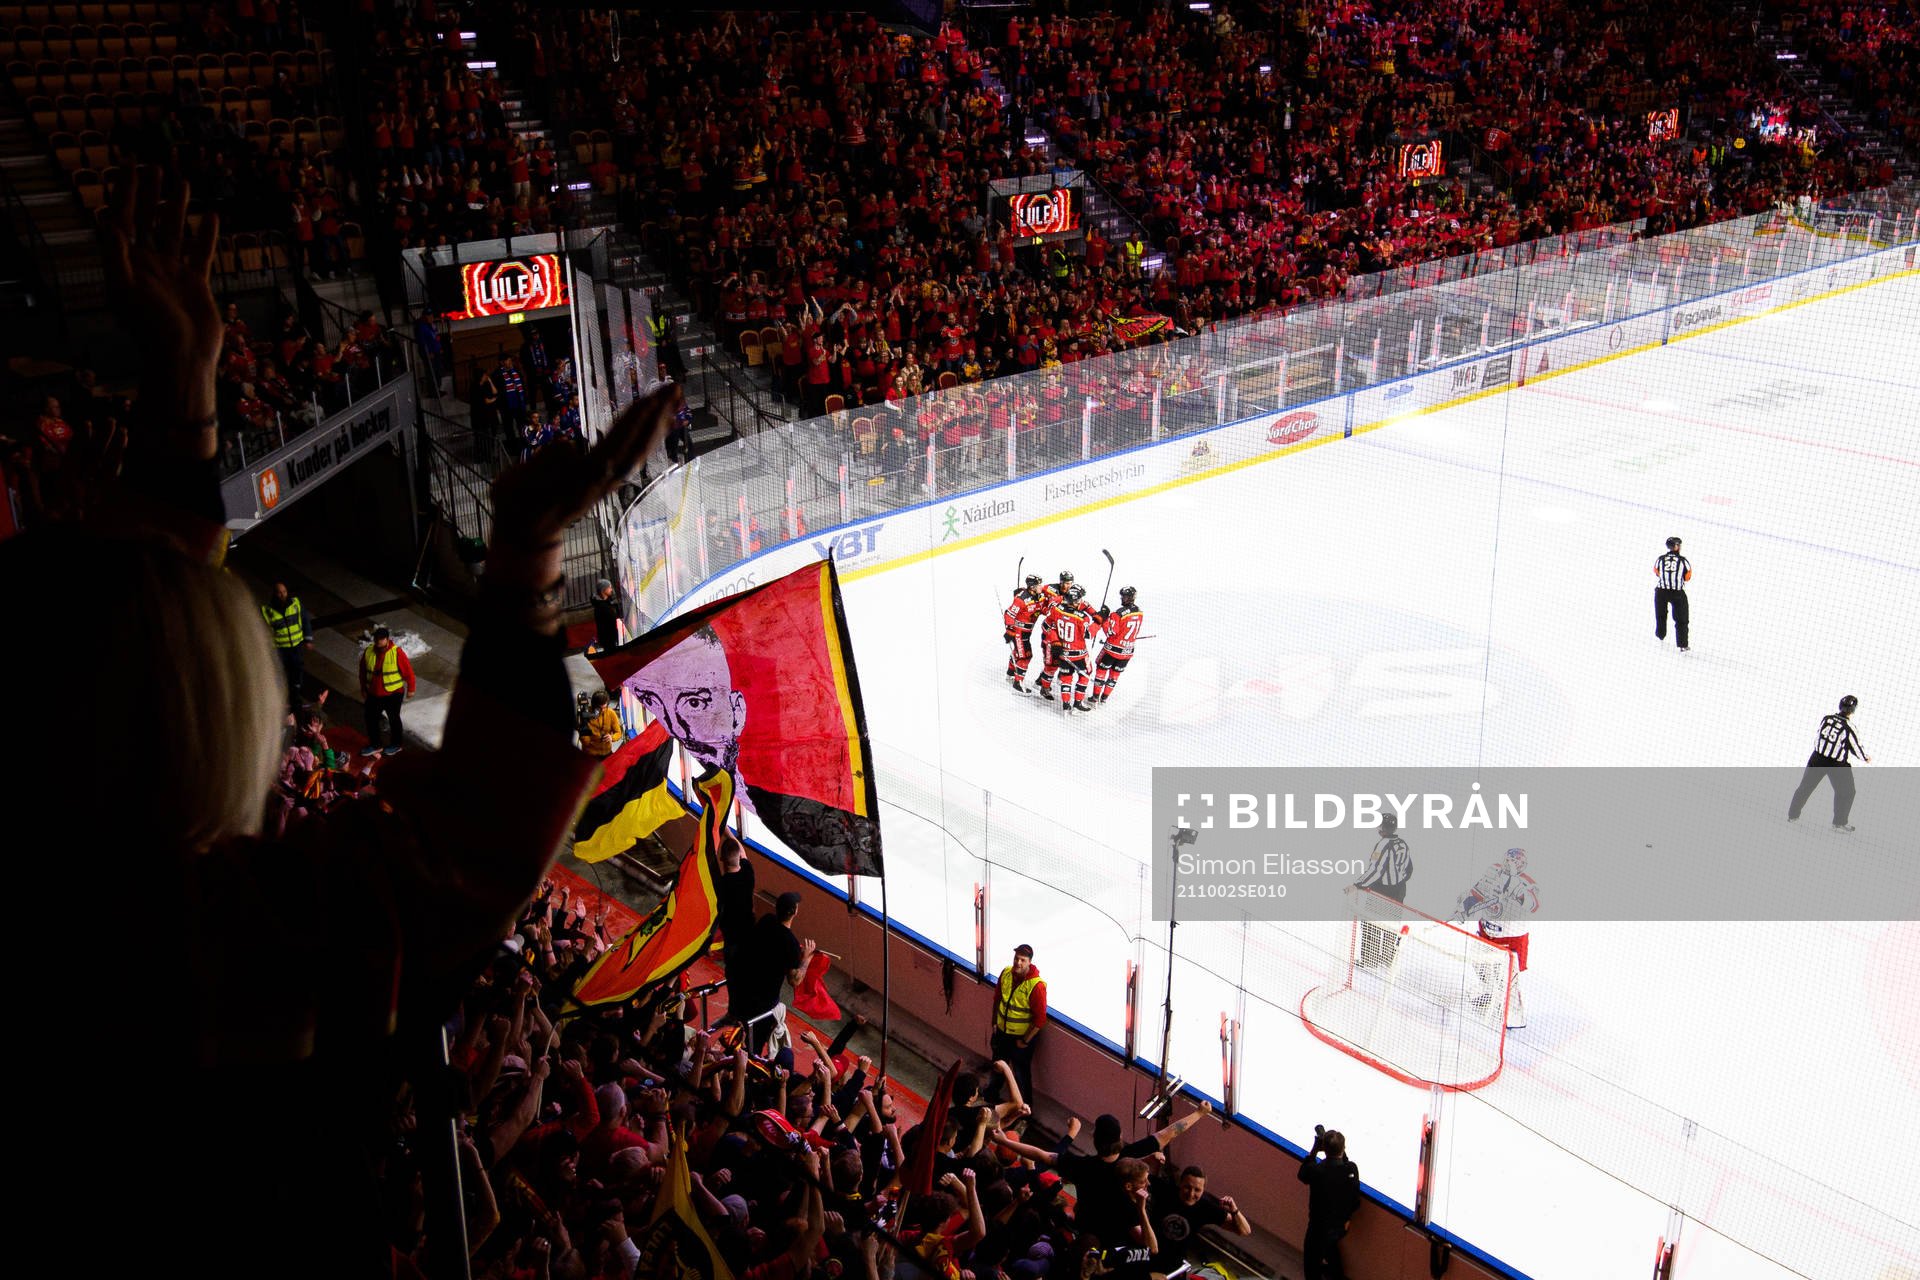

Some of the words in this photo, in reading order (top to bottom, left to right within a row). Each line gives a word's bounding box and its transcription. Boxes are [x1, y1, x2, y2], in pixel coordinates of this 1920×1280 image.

[1020, 196, 1059, 228] LULEÅ
[480, 264, 545, 304] LULEÅ
[286, 444, 332, 488] Kunder
[334, 425, 350, 465] på
[351, 407, 390, 448] hockey
[1057, 618, 1075, 643] 60
[1821, 725, 1840, 742] 45
